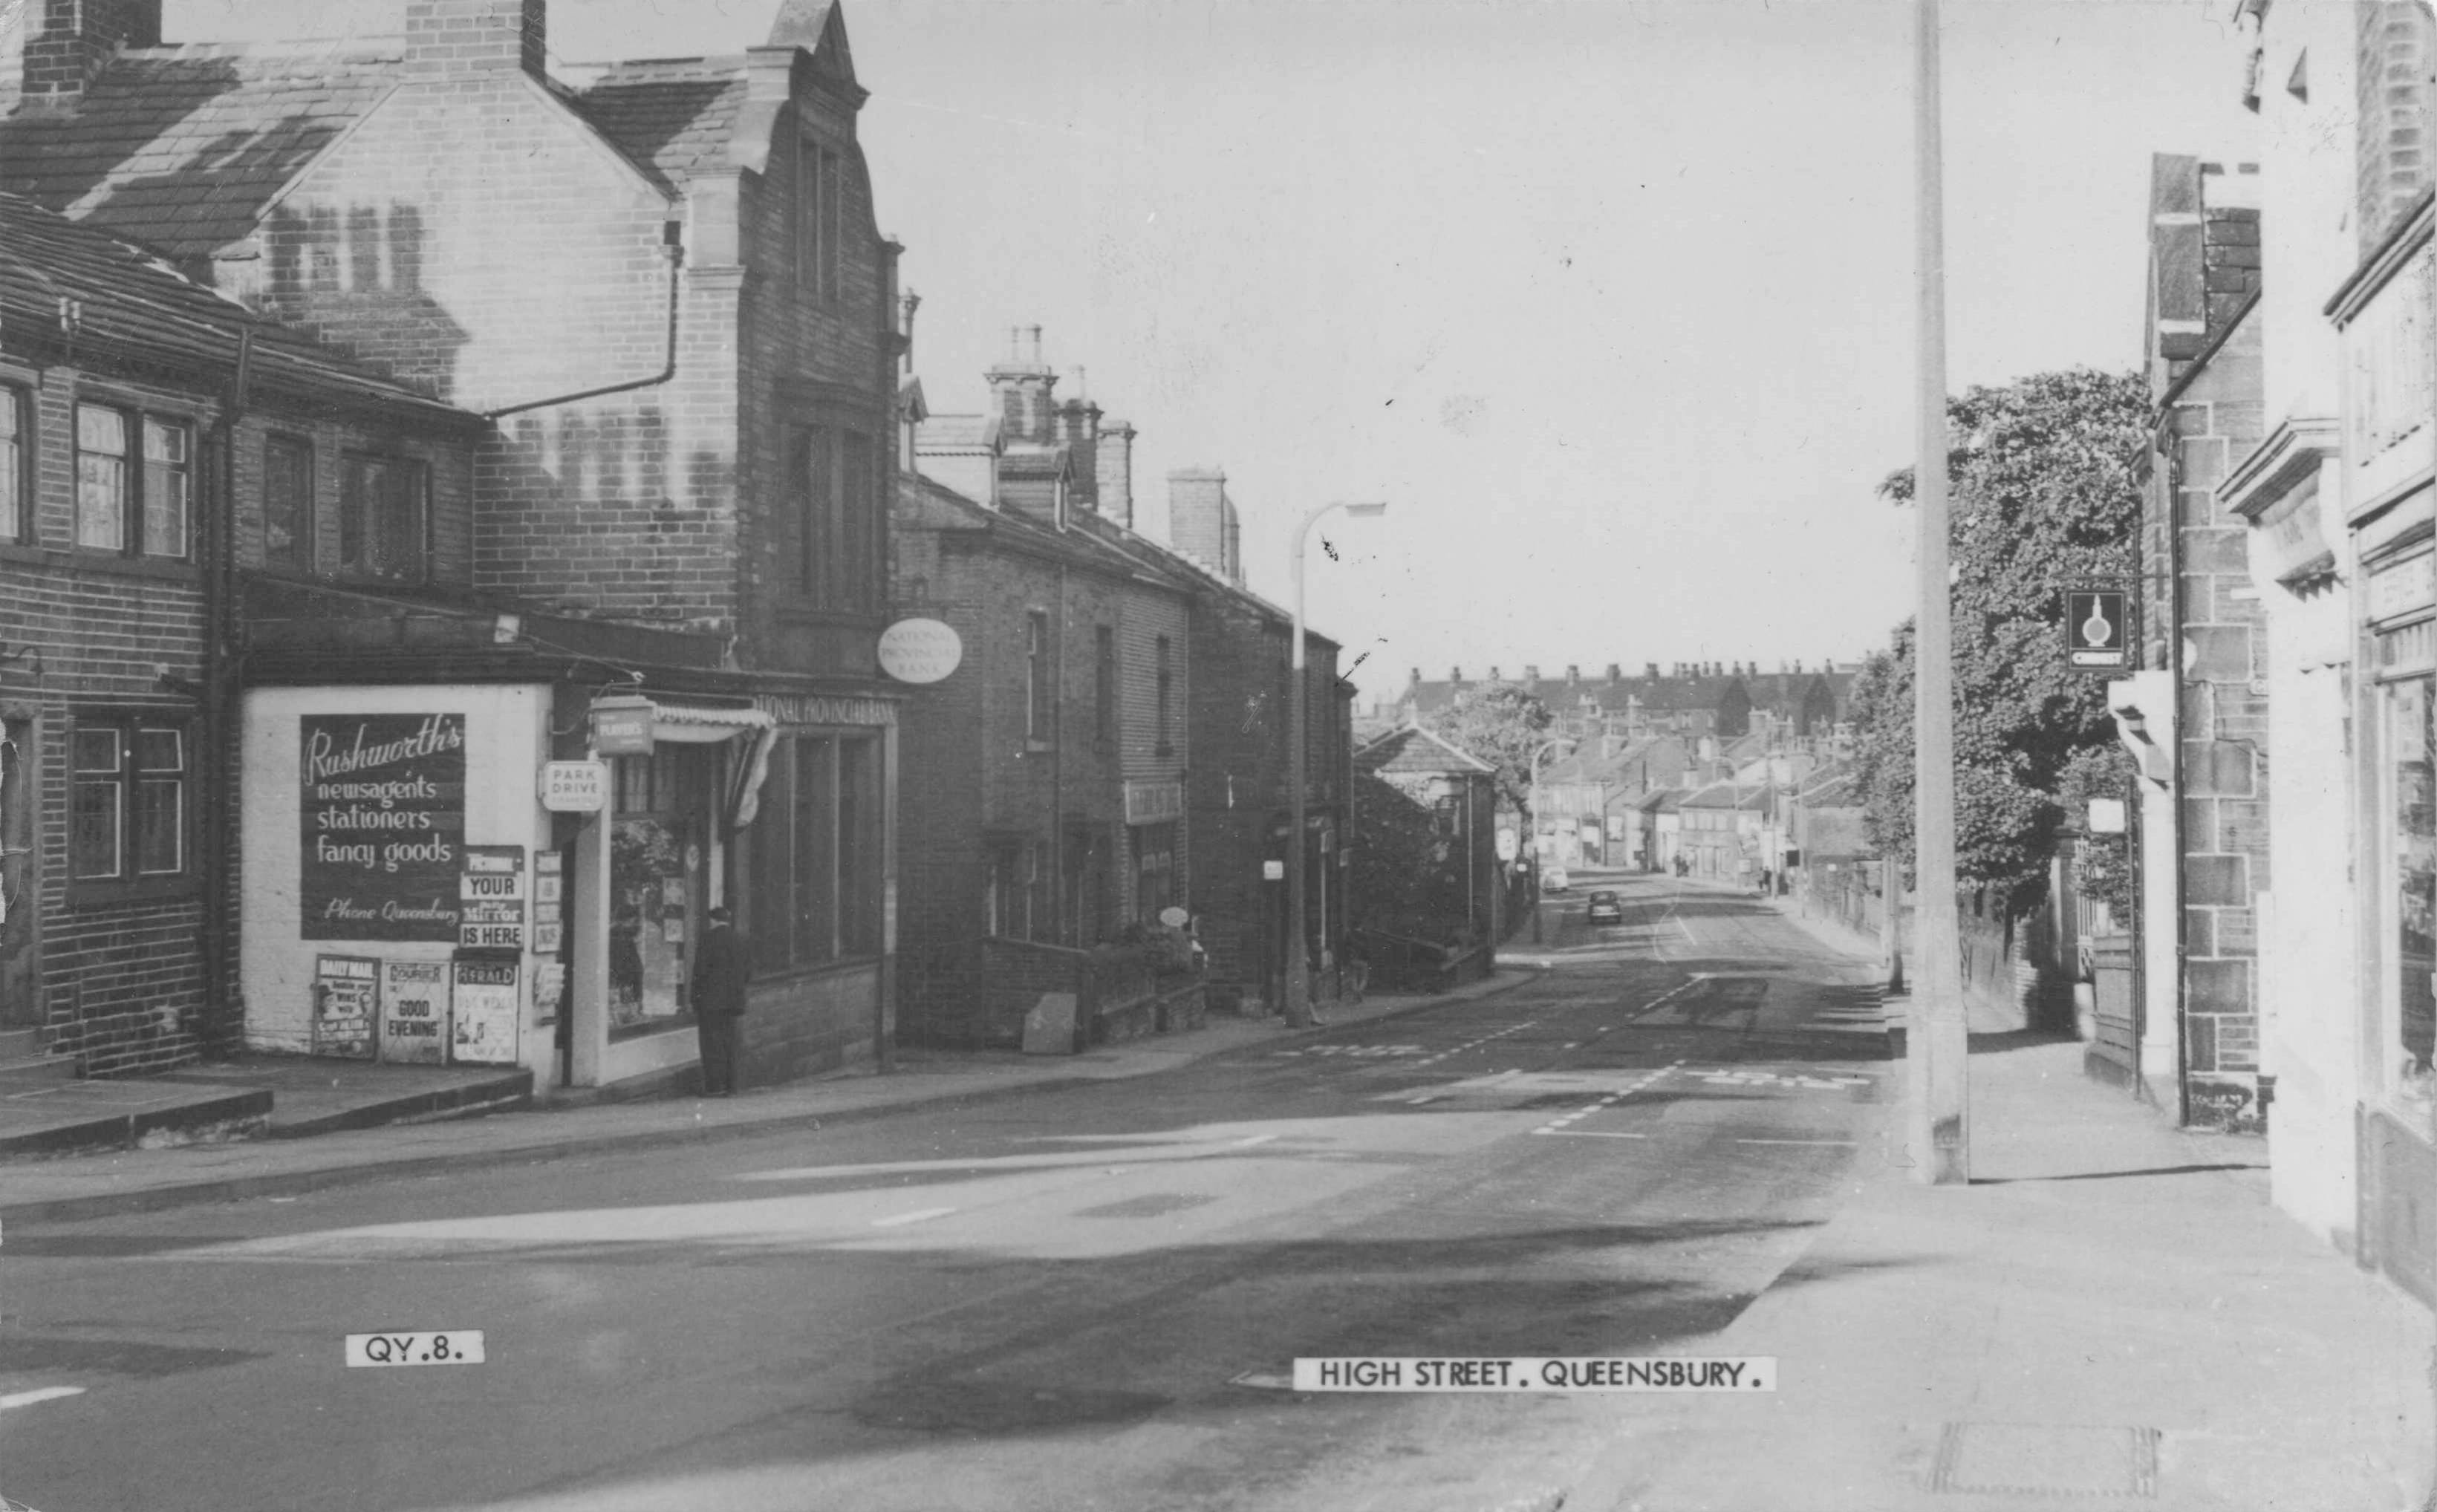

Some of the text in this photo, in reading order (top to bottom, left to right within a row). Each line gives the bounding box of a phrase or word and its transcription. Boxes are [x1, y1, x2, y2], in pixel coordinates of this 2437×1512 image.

[302, 712, 463, 787] Rushworth's
[553, 769, 596, 781] PARK
[318, 775, 437, 809] newsagents
[552, 782, 598, 793] DRIVE
[317, 804, 432, 830] stationers
[317, 834, 374, 869] fancy
[384, 832, 452, 873] goods
[469, 877, 515, 896] YOUR
[324, 896, 377, 919] Phone
[463, 907, 521, 922] Mirror
[463, 927, 478, 945] IS
[482, 927, 521, 945] HERE
[458, 966, 515, 984] HERALD
[399, 1000, 430, 1017] GOOD
[388, 1020, 438, 1037] EVENING
